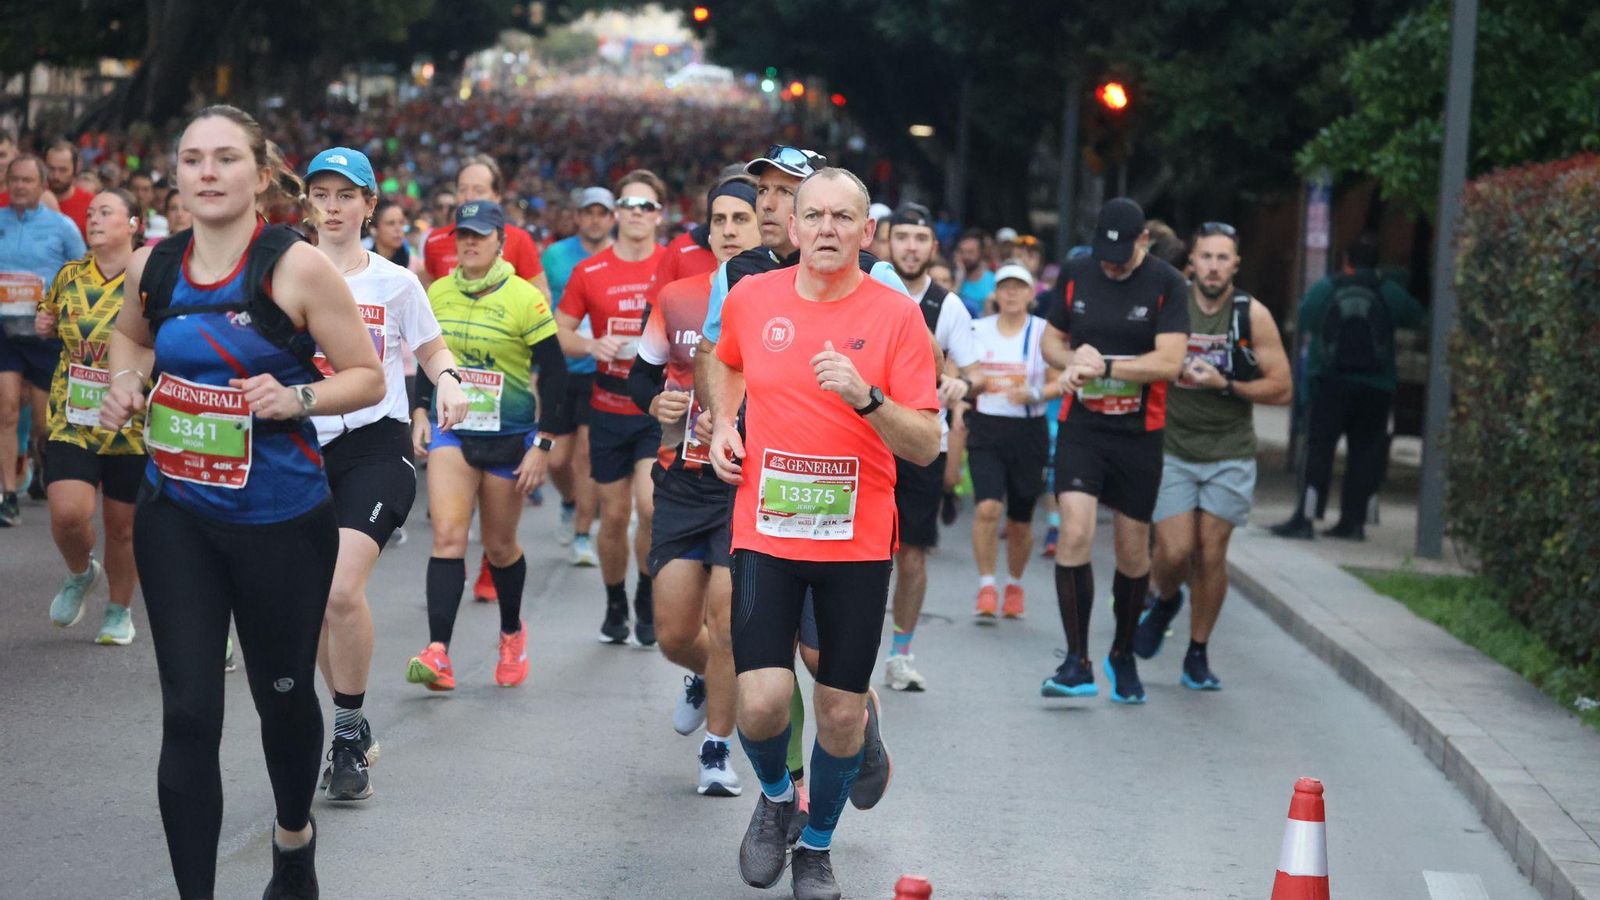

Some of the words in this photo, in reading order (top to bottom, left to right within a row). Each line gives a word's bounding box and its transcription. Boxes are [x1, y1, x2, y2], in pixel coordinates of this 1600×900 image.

[359, 307, 380, 319] RALI
[771, 327, 786, 341] TBS
[83, 371, 110, 384] GENE
[172, 383, 243, 409] GENERALI
[169, 415, 217, 441] 3341
[212, 462, 233, 470] 42K
[786, 459, 851, 474] GENERALI
[779, 485, 835, 505] 13375
[369, 501, 383, 523] FUSION
